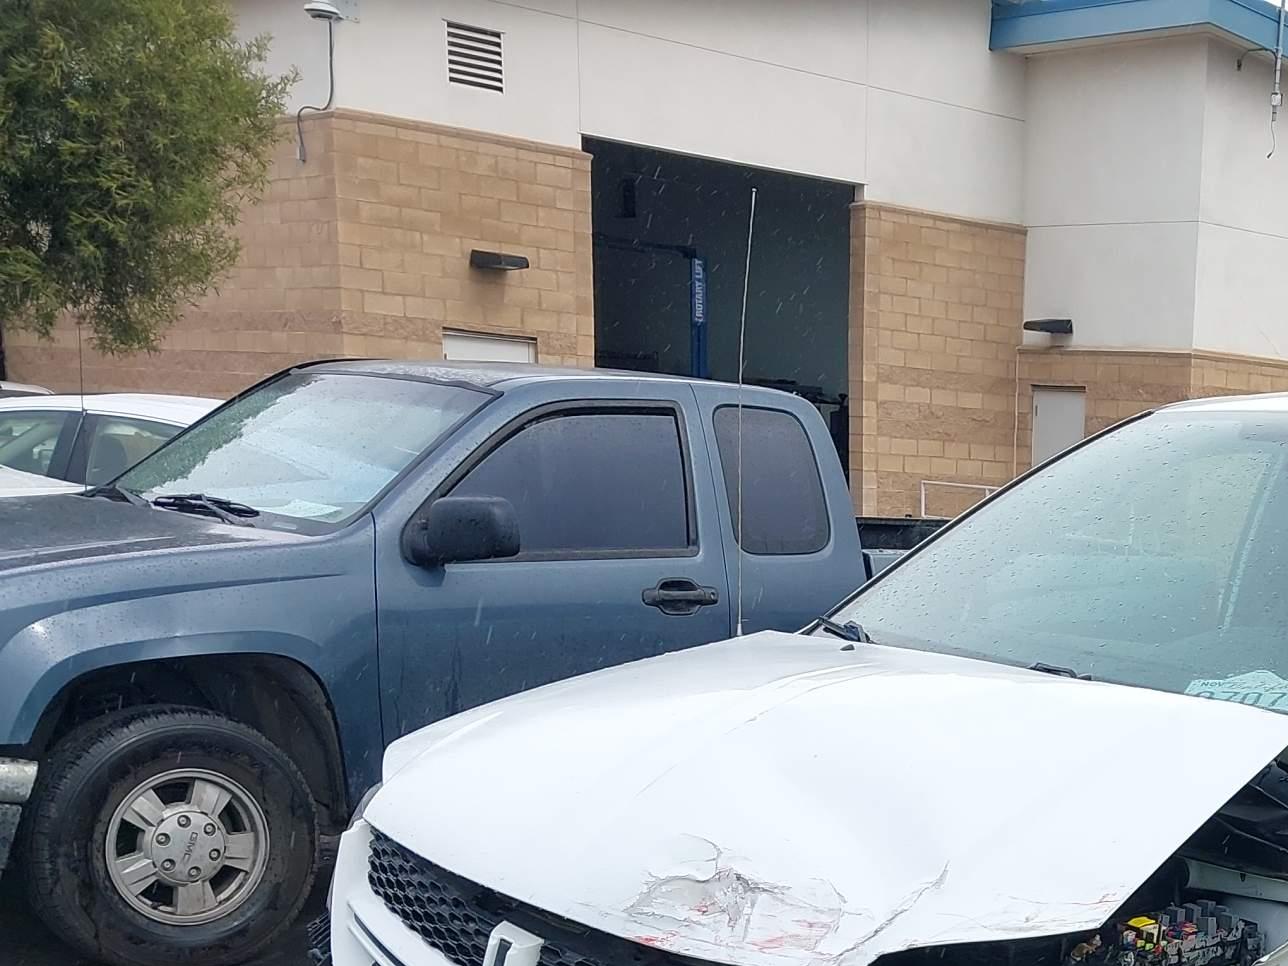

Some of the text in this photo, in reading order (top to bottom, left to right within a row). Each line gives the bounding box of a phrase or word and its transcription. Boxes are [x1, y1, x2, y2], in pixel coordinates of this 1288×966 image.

[694, 280, 704, 318] ROTARY
[1200, 680, 1225, 688] NOV
[182, 831, 199, 865] GMC
